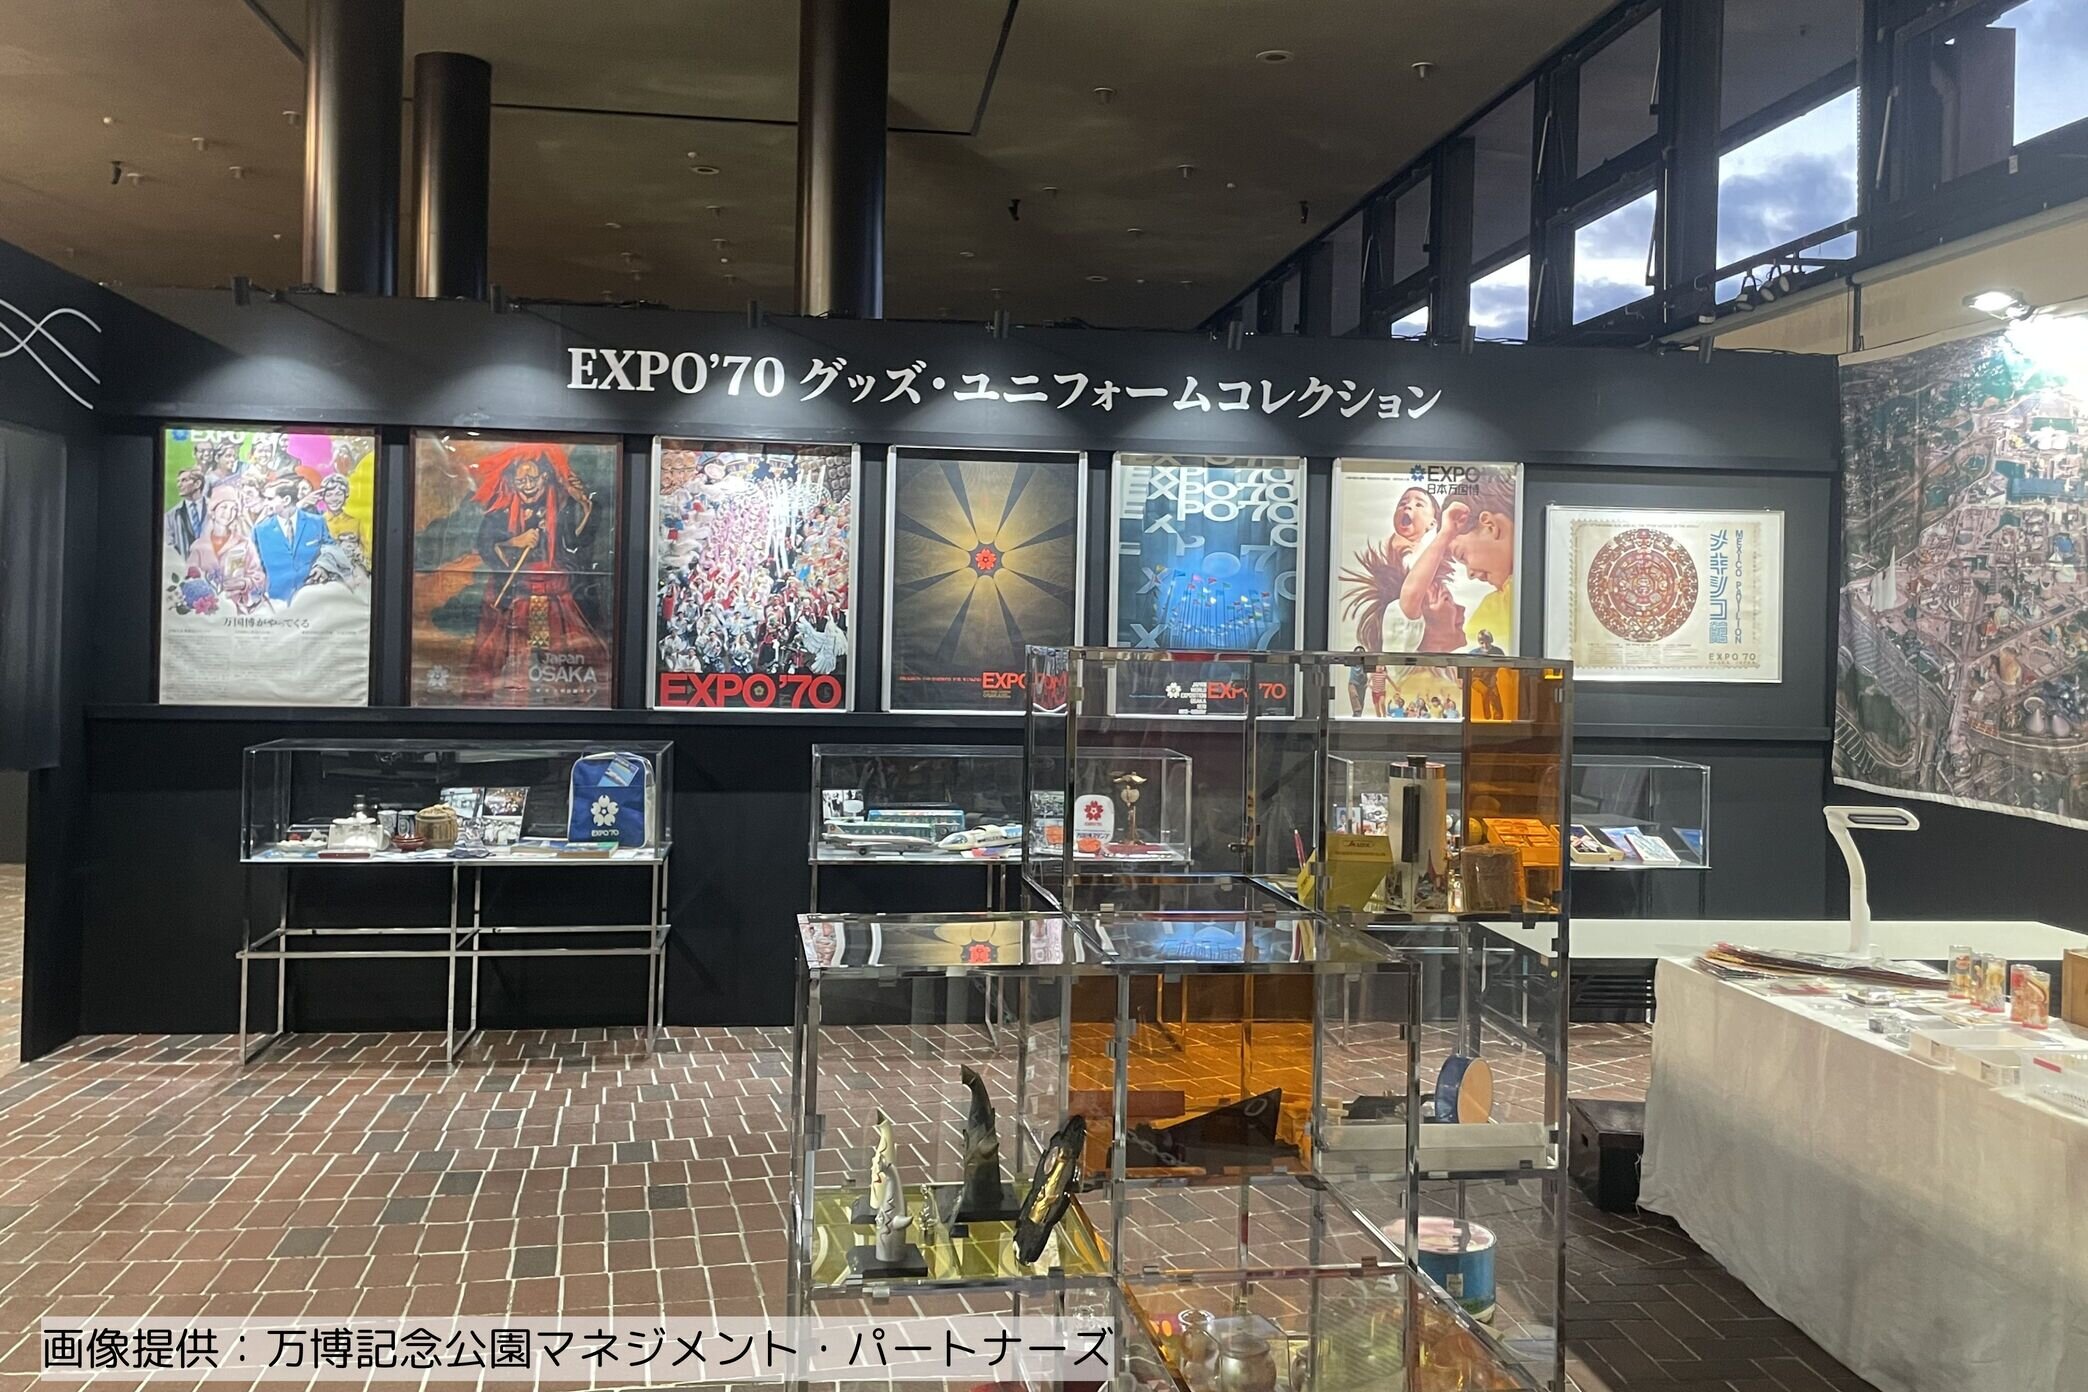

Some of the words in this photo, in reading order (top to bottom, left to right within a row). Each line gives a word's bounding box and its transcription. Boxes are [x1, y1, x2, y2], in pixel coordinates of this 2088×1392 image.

[567, 347, 785, 398] EXPO'70
[800, 356, 1442, 419] グッズ・ユニフォームコレクション
[1427, 483, 1480, 497] 日本万国博
[1735, 529, 1744, 578] MEXICO
[1709, 529, 1728, 644] メキシコ館
[1734, 581, 1743, 645] PAVILION
[528, 664, 597, 684] OSAKA
[541, 652, 585, 666] Japan
[659, 672, 843, 710] EXPO'70
